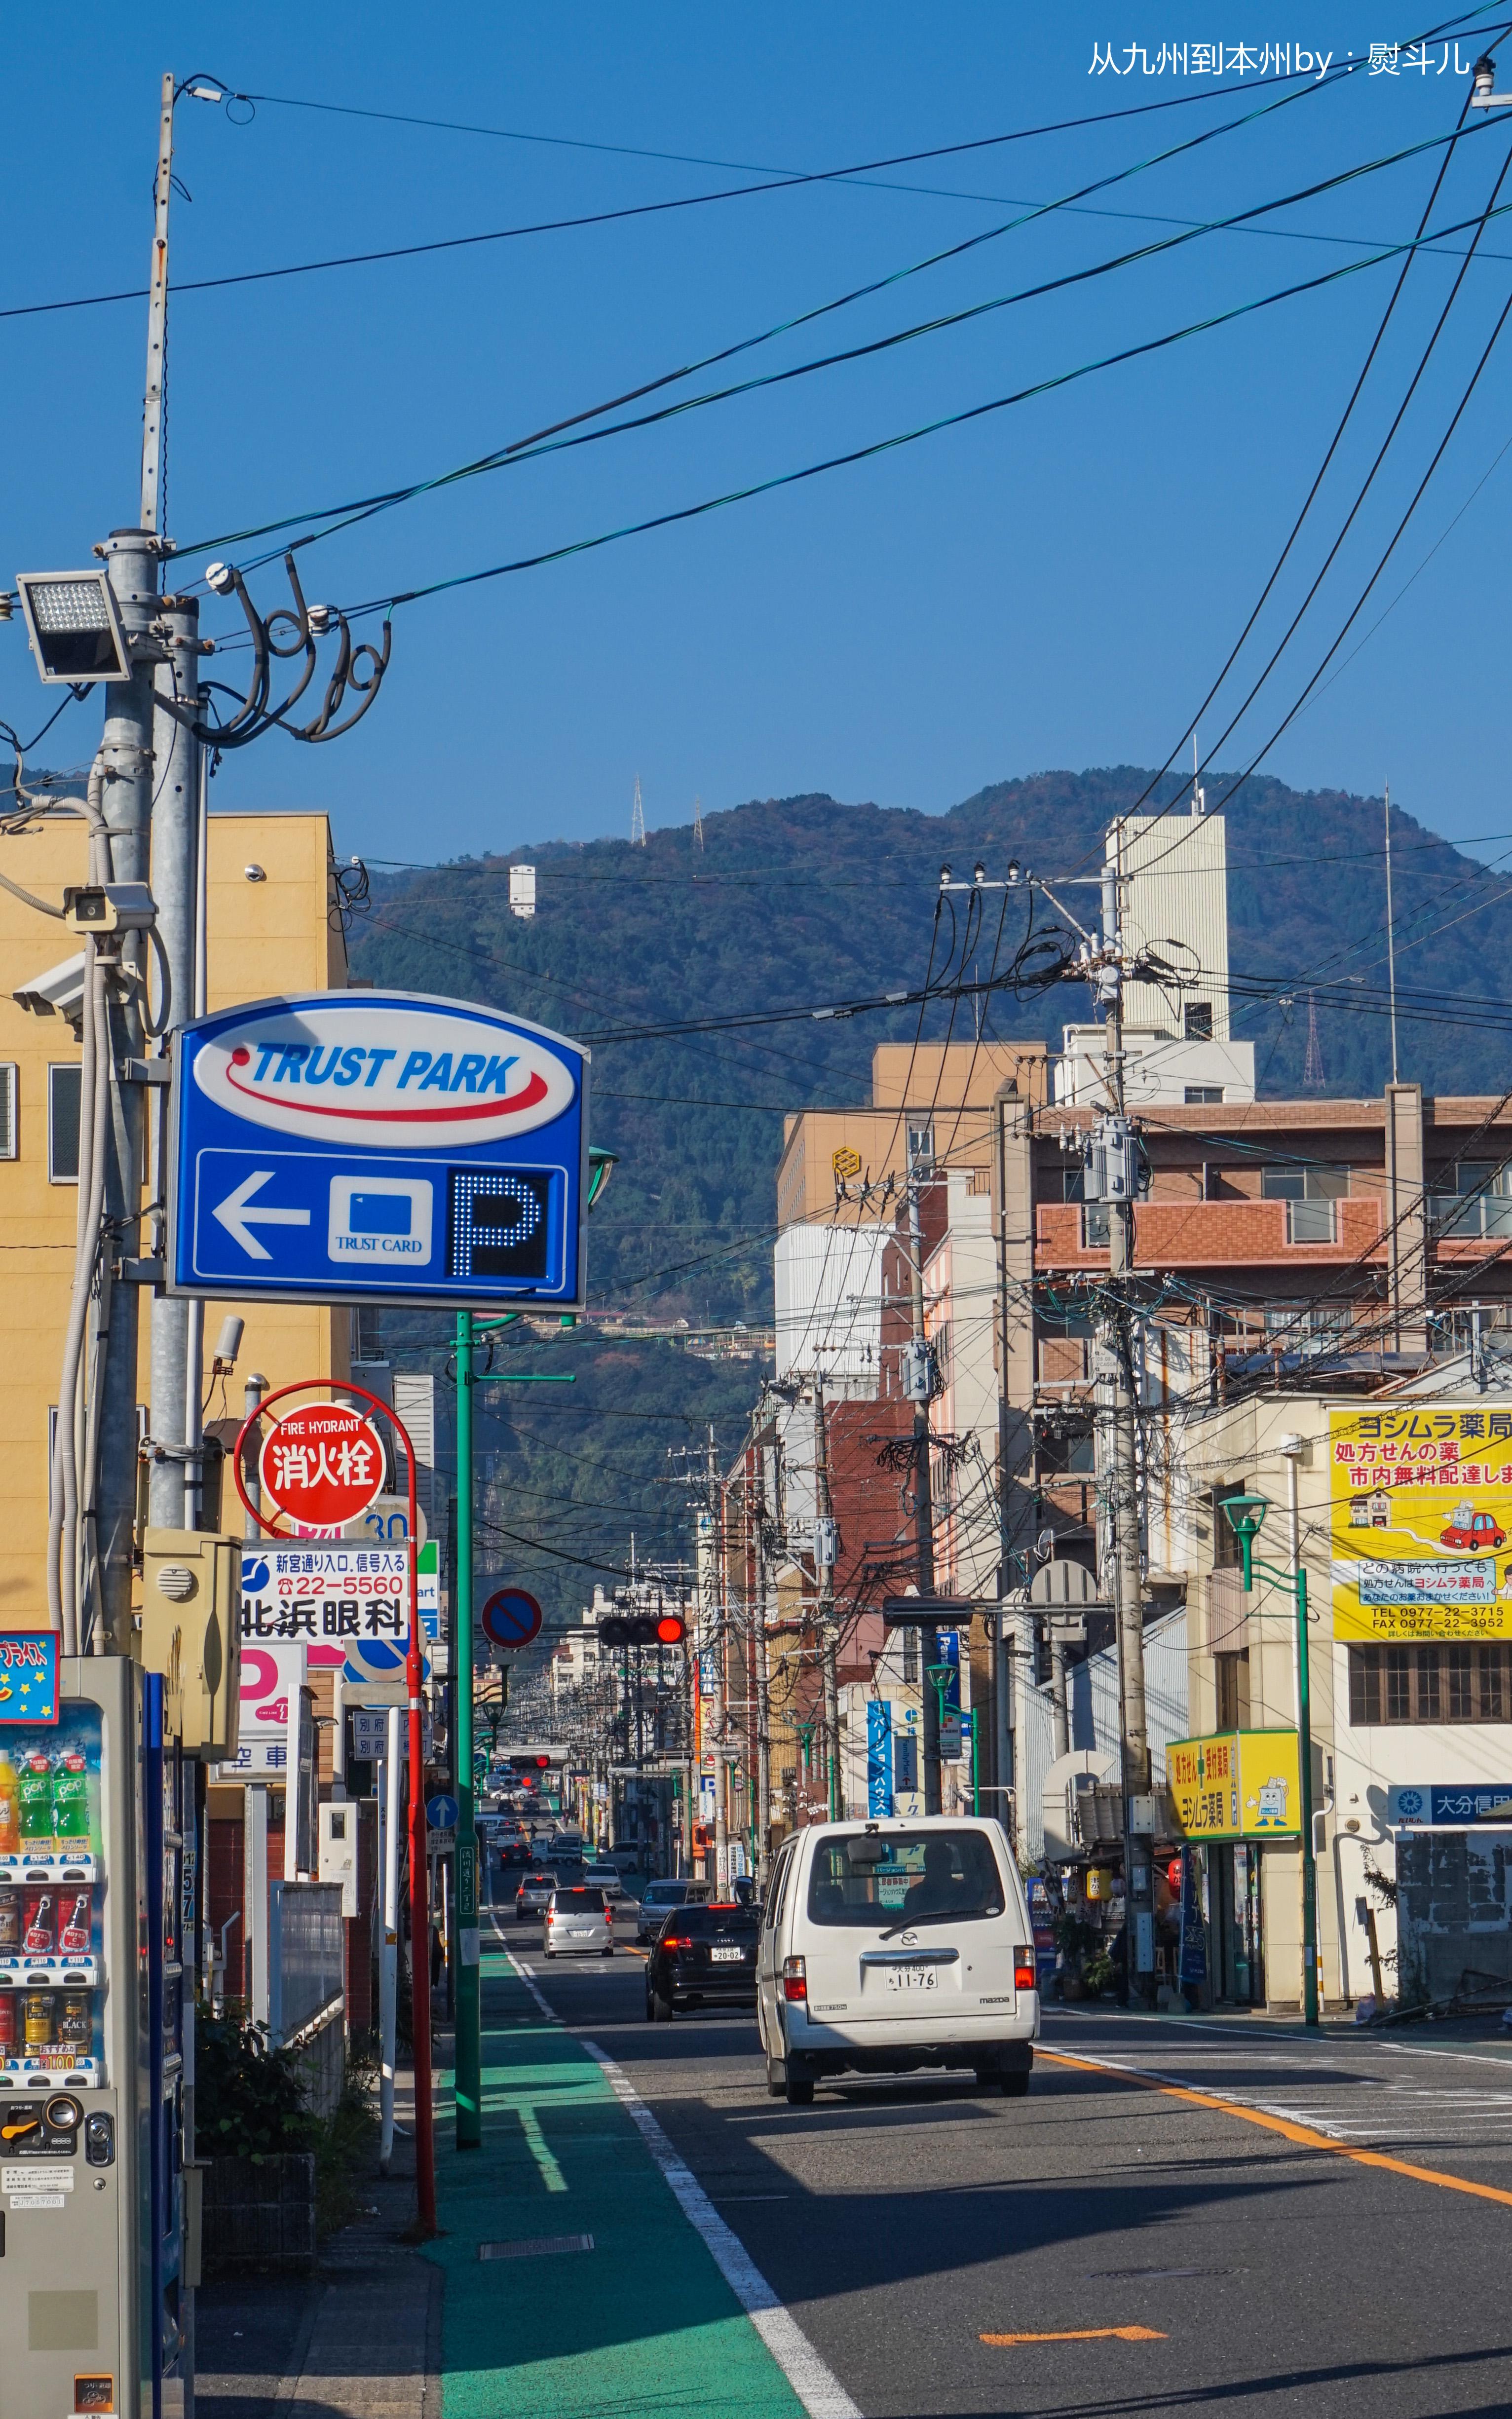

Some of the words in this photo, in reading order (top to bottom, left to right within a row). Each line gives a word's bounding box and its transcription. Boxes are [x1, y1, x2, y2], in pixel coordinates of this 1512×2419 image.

[253, 1042, 397, 1088] TRUST
[396, 1050, 520, 1094] PARK
[454, 1174, 541, 1277] P
[336, 1236, 379, 1251] TRUST
[382, 1239, 422, 1253] CARD
[281, 1422, 305, 1436] FIRE
[309, 1419, 359, 1434] HYDRANT
[1359, 1414, 1512, 1439] ヨシムラ薬局
[1336, 1442, 1460, 1463] 処方せんの薬
[272, 1439, 374, 1490] 消火栓
[1363, 1562, 1487, 1574] どの病院へ行っても
[241, 1598, 404, 1637] 北浜眼科
[1372, 1608, 1395, 1617] TEL
[1206, 1746, 1228, 1780] 受付薬局
[23, 1781, 46, 1798] pop
[59, 1780, 81, 1798] pop
[1182, 1792, 1223, 1829] ヨシムラ薬局
[898, 1973, 934, 1987] 11-76
